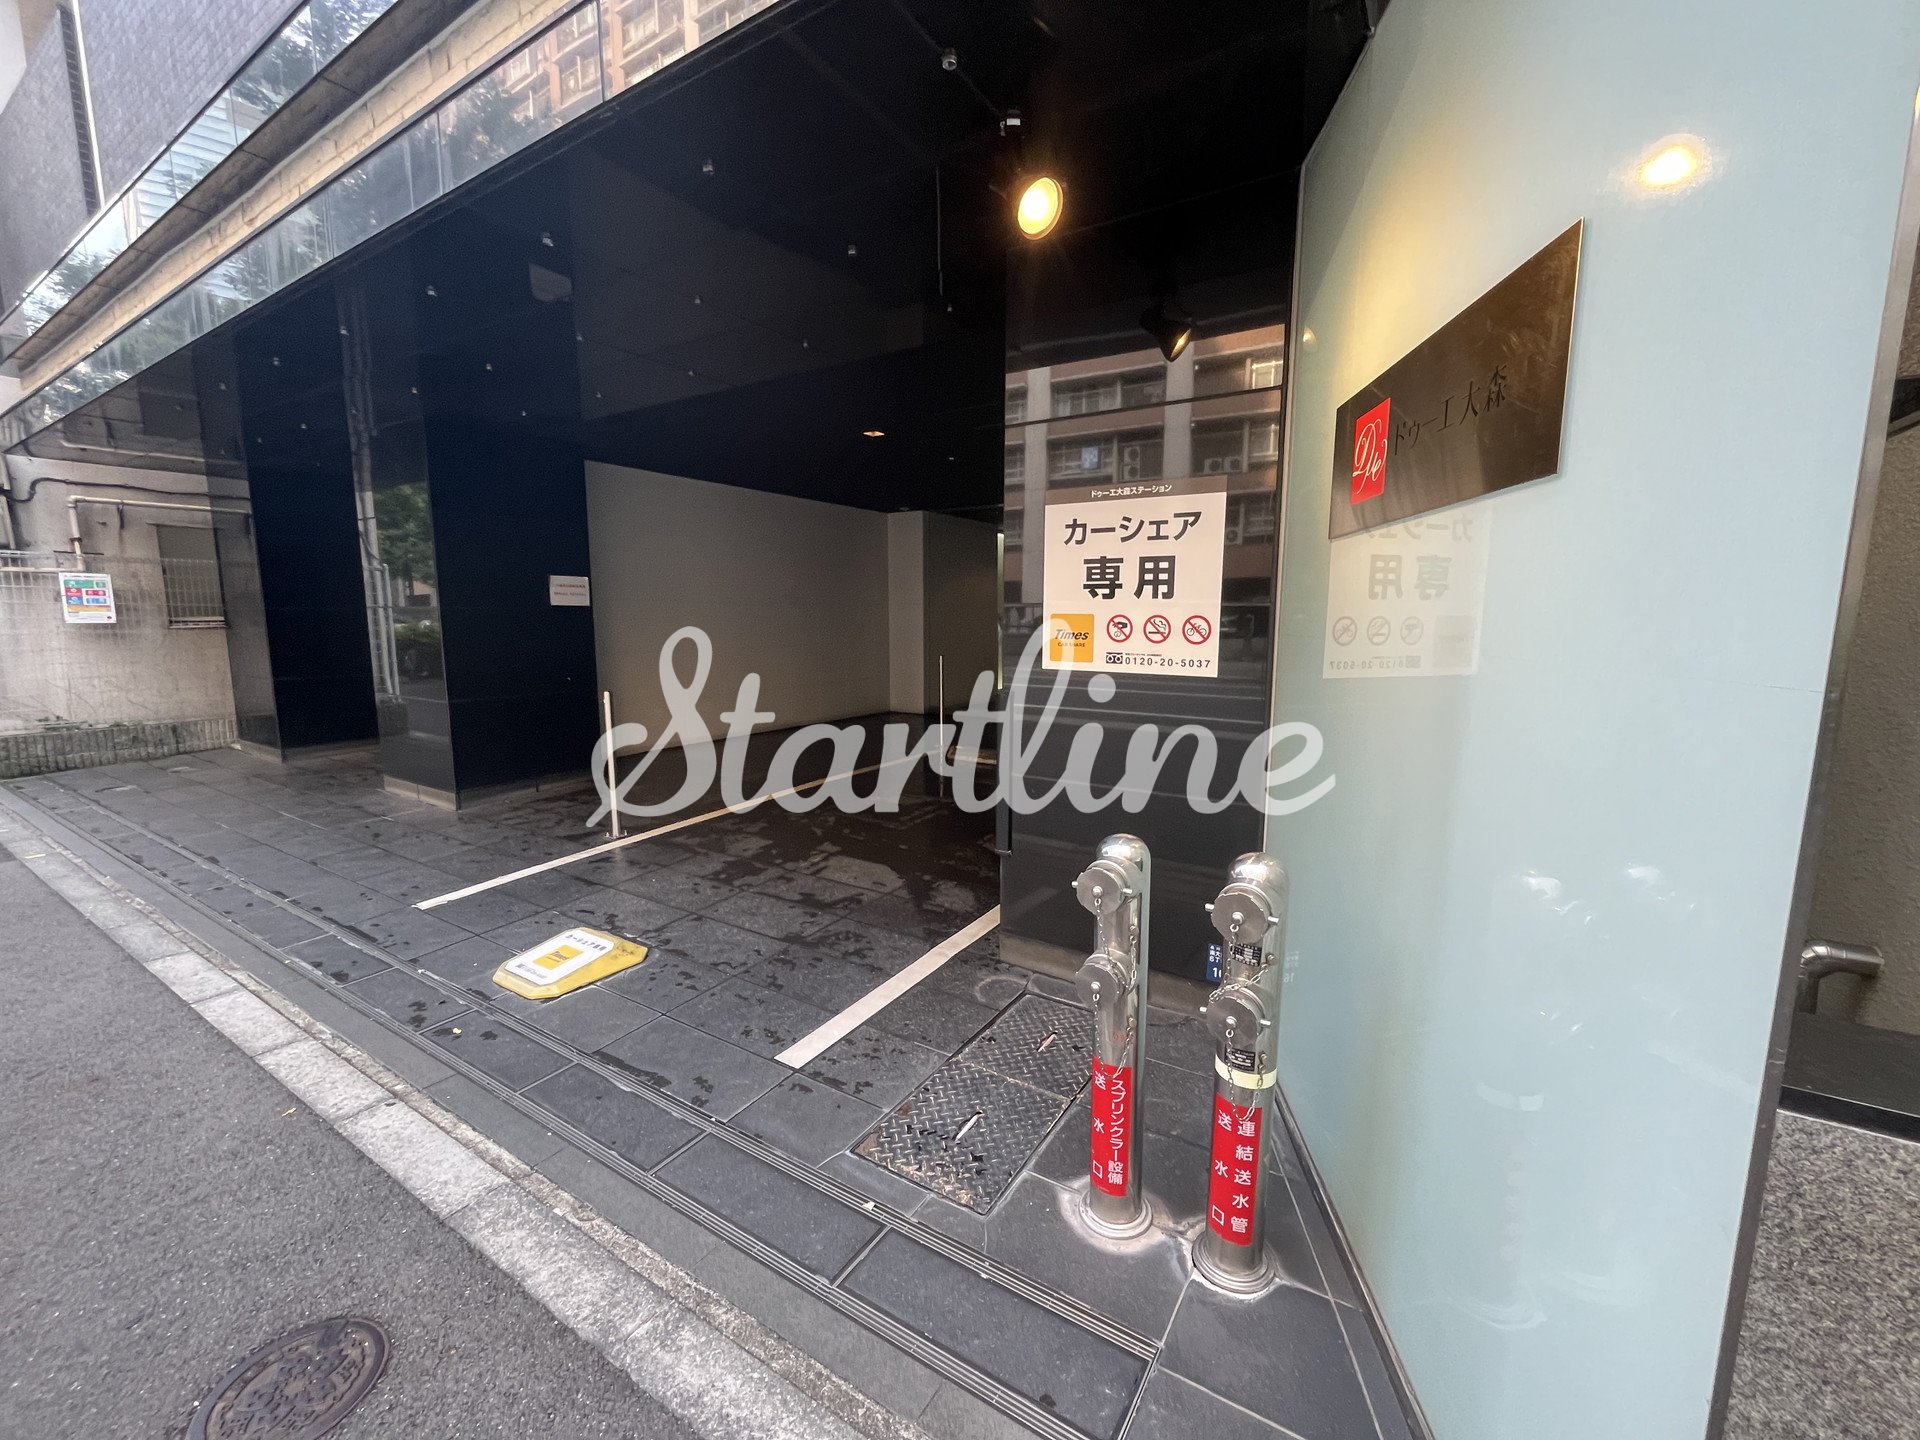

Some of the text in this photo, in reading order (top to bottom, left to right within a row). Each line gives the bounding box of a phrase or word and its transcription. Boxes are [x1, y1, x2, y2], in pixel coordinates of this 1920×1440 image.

[1064, 511, 1202, 545] カーシェア
[1083, 555, 1176, 600] 専用
[1055, 629, 1089, 640] Times
[1125, 656, 1211, 668] 0120-20-5037
[1107, 1079, 1127, 1186] スプリンクラー設備
[1230, 1120, 1256, 1234] 連結送水管
